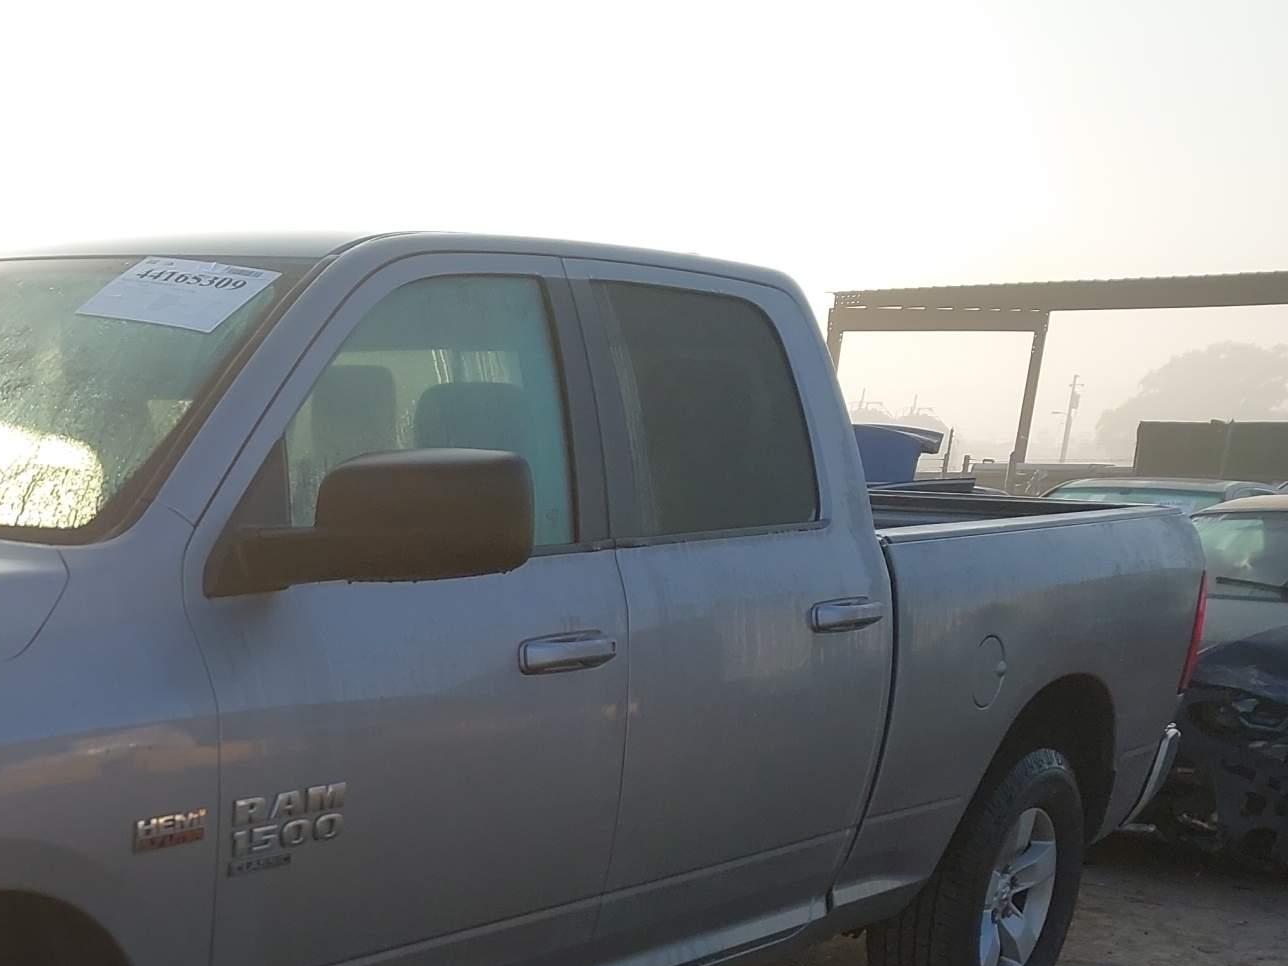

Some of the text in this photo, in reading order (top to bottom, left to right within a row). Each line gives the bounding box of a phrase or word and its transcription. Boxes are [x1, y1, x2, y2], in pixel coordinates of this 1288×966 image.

[135, 268, 248, 290] 44165309
[233, 782, 347, 826] RAM
[231, 813, 345, 858] 1500
